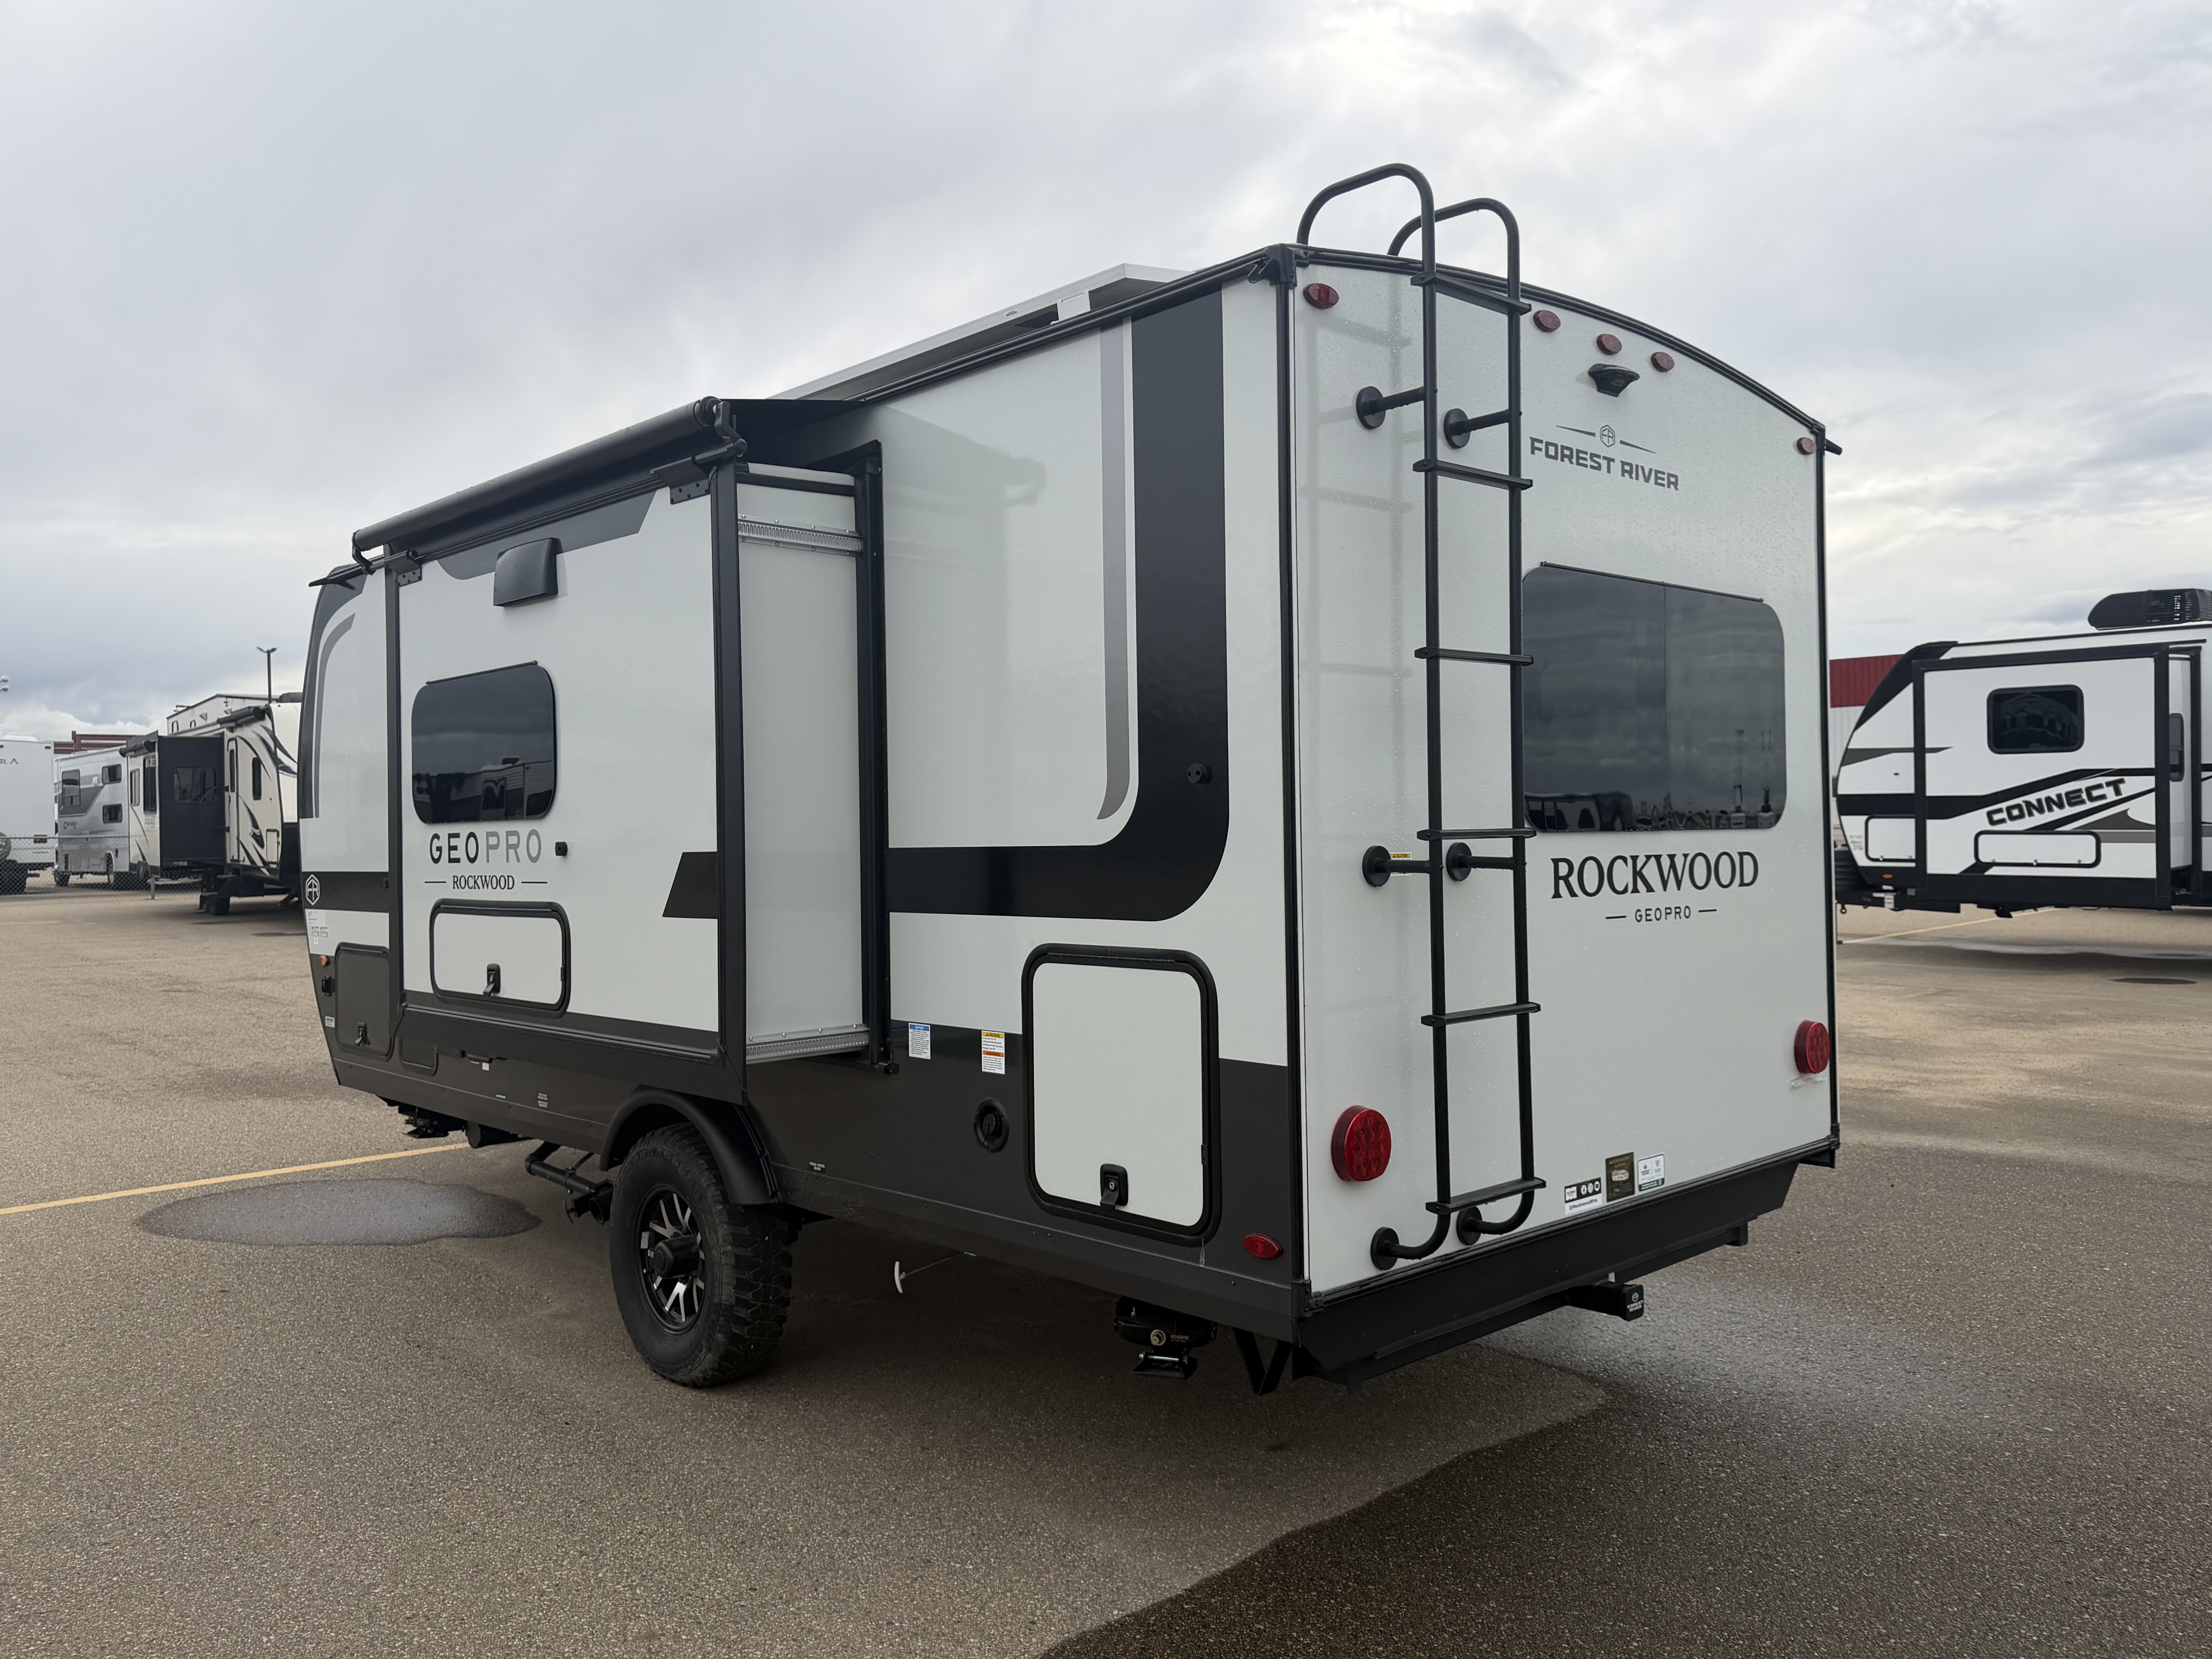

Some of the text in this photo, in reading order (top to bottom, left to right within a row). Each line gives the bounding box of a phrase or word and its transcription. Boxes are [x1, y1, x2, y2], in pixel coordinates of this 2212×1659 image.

[1529, 436, 1679, 491] FOREST RIVER
[1986, 778, 2126, 826] CONNECT
[429, 829, 542, 864] GEOPRO
[452, 874, 515, 890] ROCKWOOD
[1550, 851, 1759, 899] ROCKWOOD
[1635, 905, 1692, 923] GEOPRO
[1627, 1300, 1644, 1309] FOREST
[1629, 1304, 1642, 1312] RIVER
